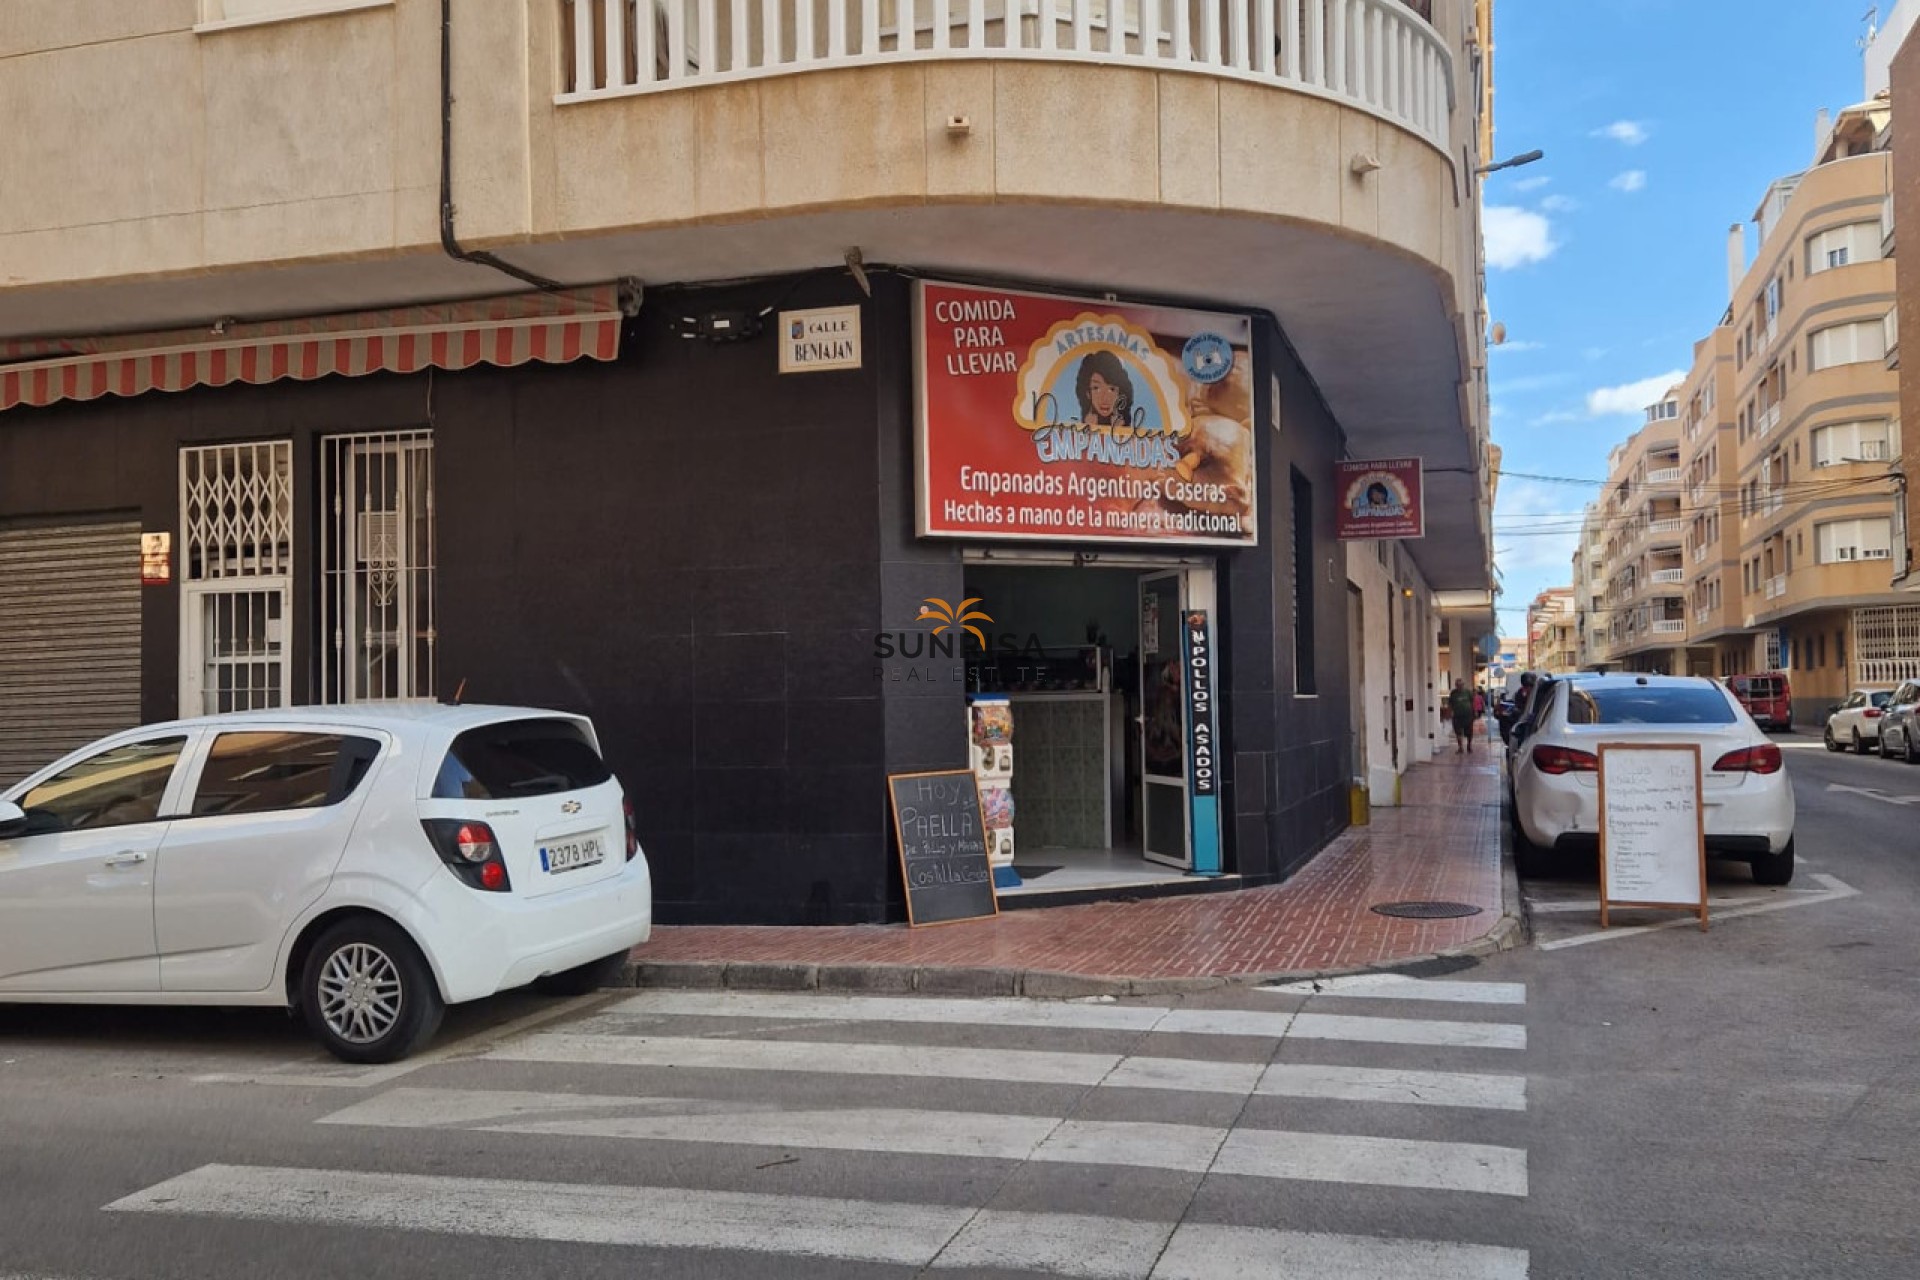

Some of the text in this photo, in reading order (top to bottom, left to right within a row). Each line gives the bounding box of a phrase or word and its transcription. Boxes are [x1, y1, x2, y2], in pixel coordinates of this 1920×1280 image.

[935, 299, 1016, 323] COMIDA
[809, 320, 850, 334] CALLE
[954, 325, 1005, 349] PARA
[794, 340, 853, 362] BENIAJAN
[1056, 326, 1151, 360] ARTESANAS
[947, 350, 1018, 375] LLEVAR
[1036, 427, 1182, 470] EMPANADAS
[961, 465, 1227, 503] Empanadas Argentinas Caseras
[944, 499, 1243, 533] Hechas a mano de la manera tradicional
[1194, 722, 1212, 790] ASADOS
[549, 839, 604, 867] 2378 HPL
